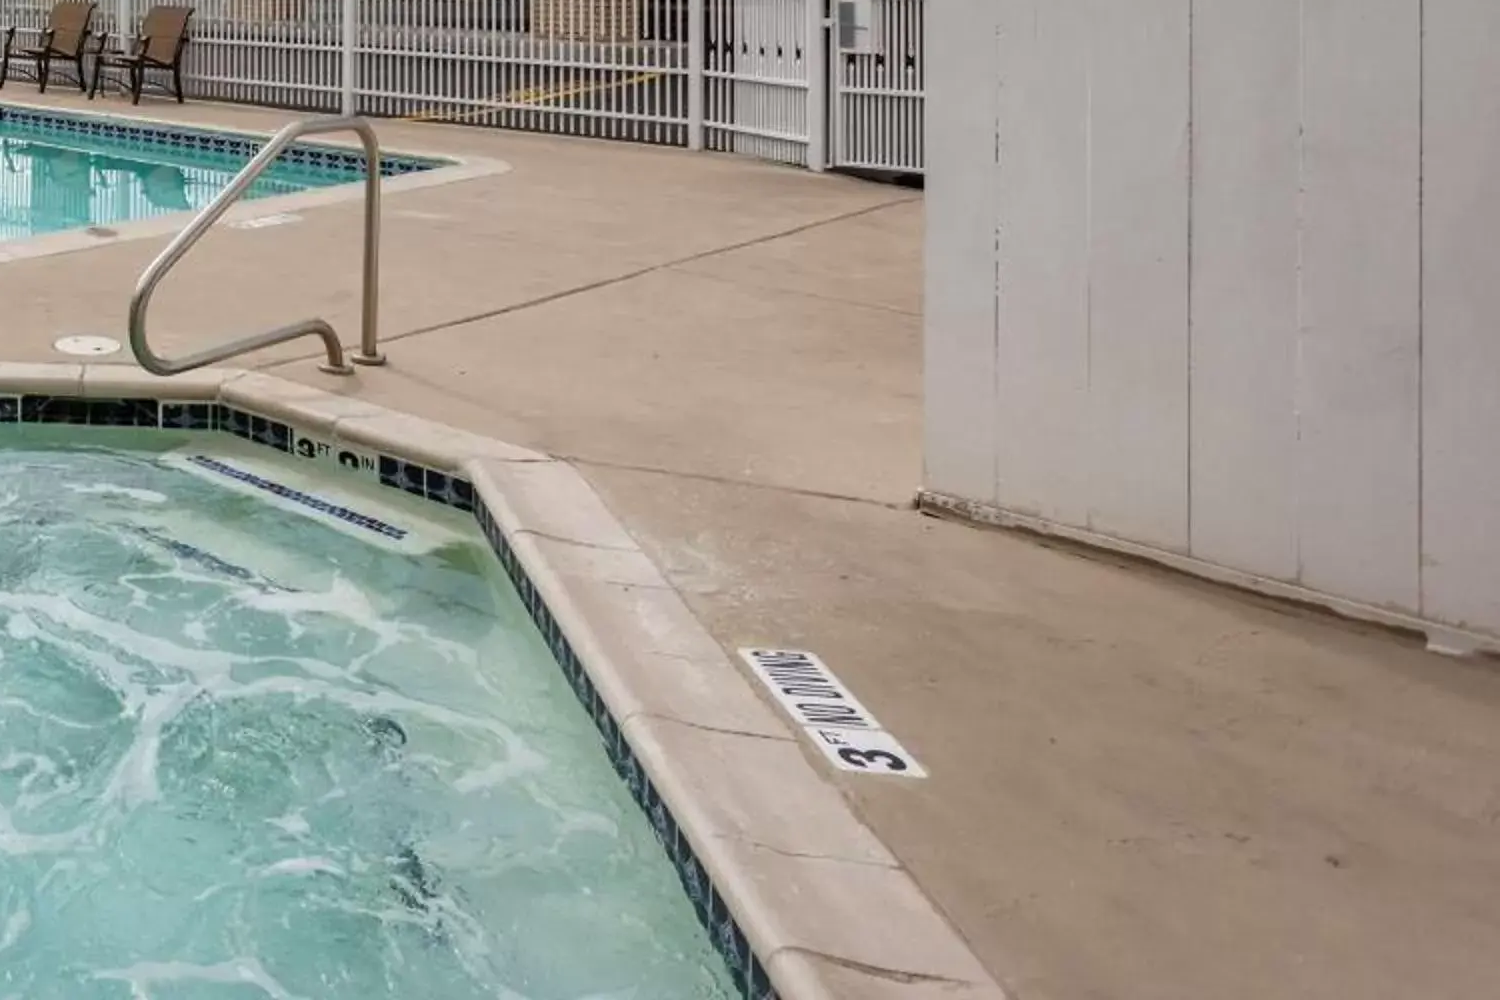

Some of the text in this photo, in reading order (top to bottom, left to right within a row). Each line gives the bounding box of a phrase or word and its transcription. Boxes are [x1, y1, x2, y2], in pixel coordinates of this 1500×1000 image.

[752, 650, 869, 728] NO DIVING
[818, 728, 907, 771] 3 FT
